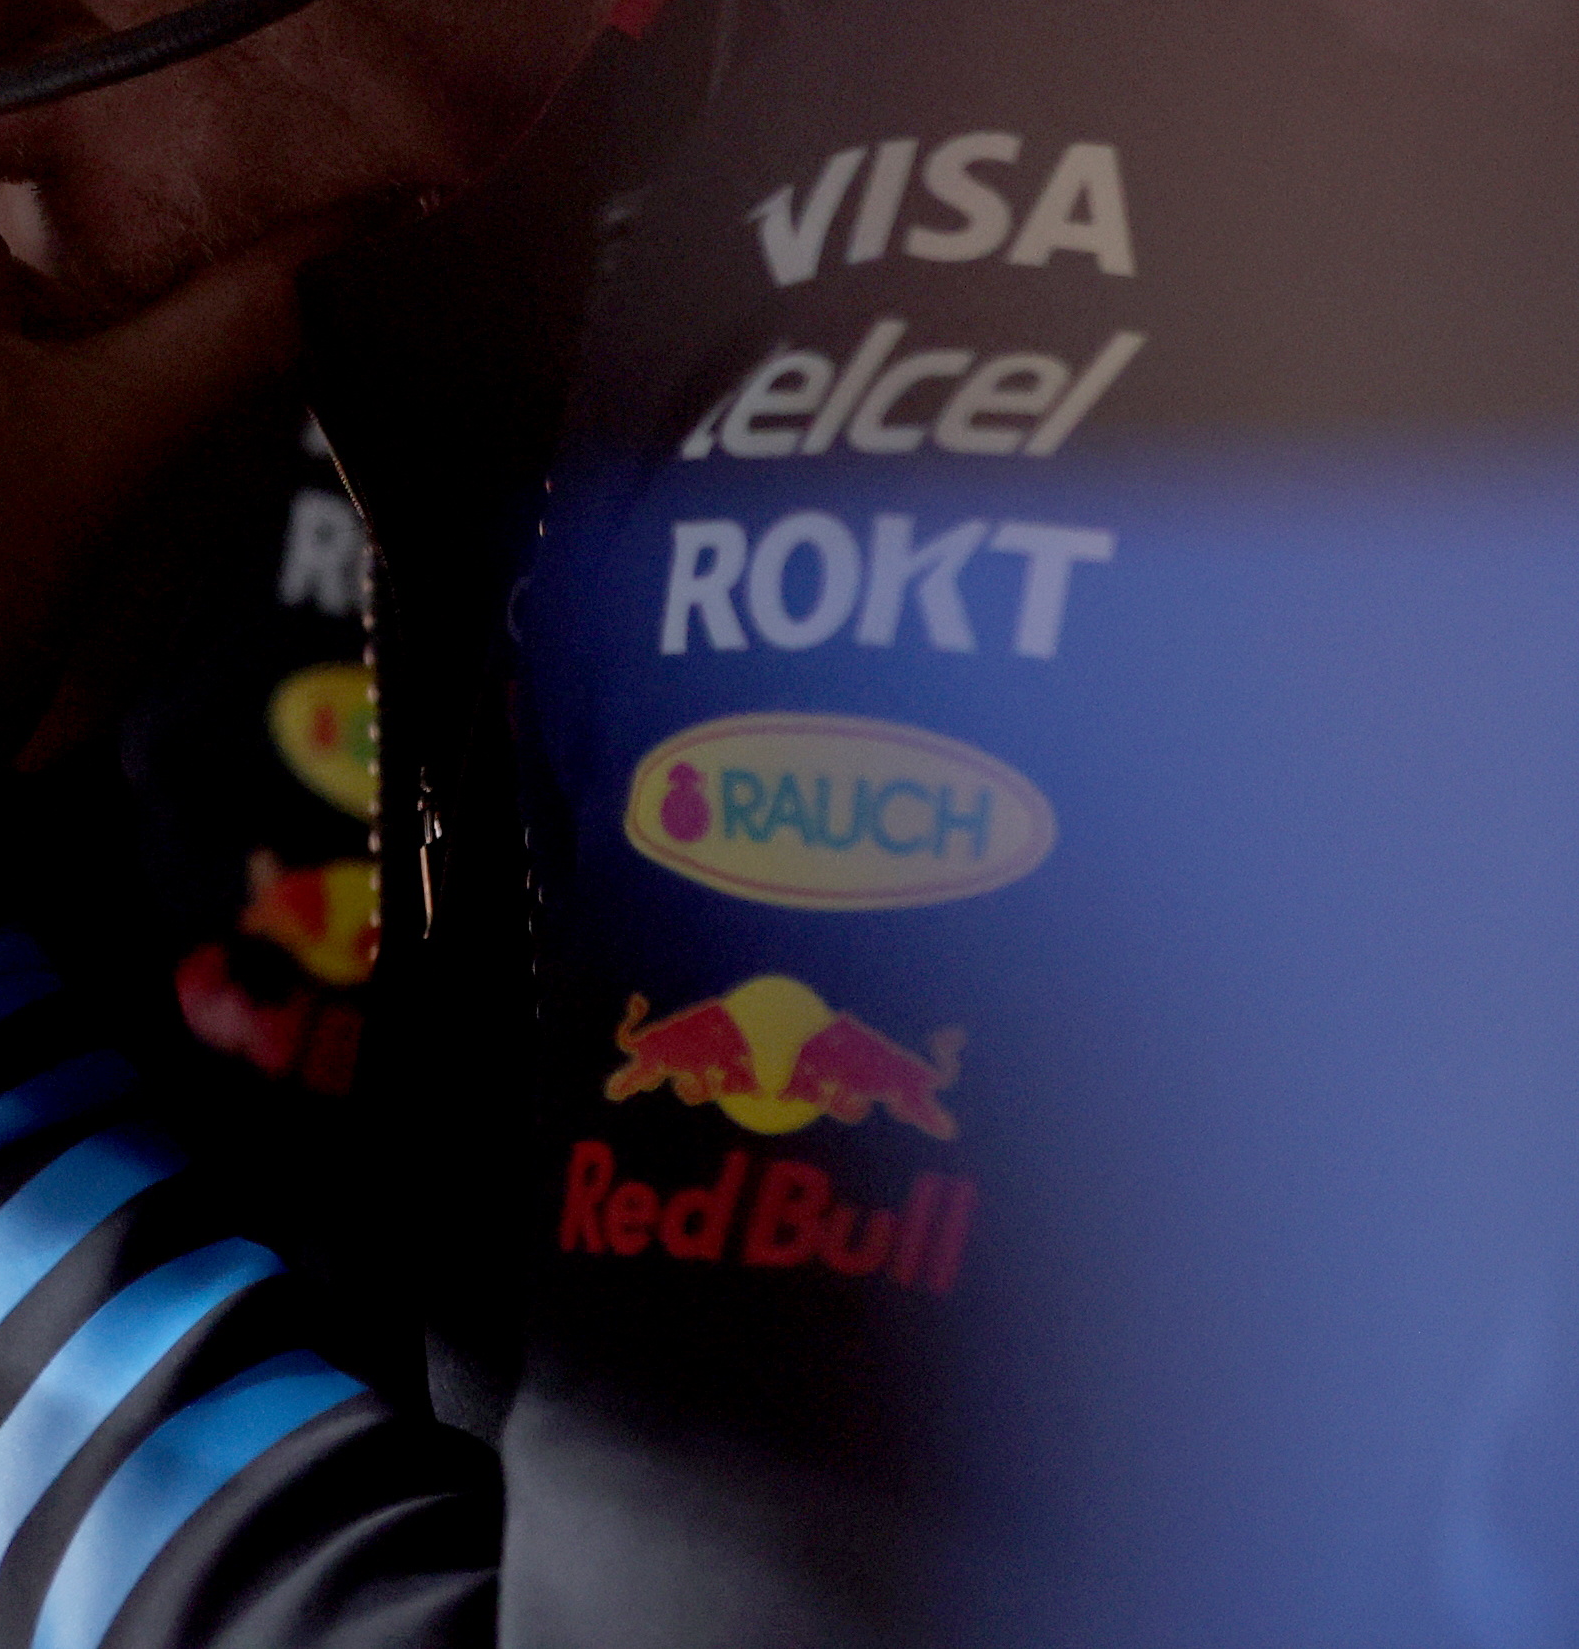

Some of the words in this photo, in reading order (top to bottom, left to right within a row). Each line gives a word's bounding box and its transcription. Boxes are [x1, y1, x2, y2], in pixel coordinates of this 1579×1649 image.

[747, 132, 1137, 287] VISA
[660, 508, 1116, 660] ROKT
[720, 767, 993, 861] RAUCH
[558, 1139, 749, 1262] Red
[743, 1156, 979, 1298] Bull
